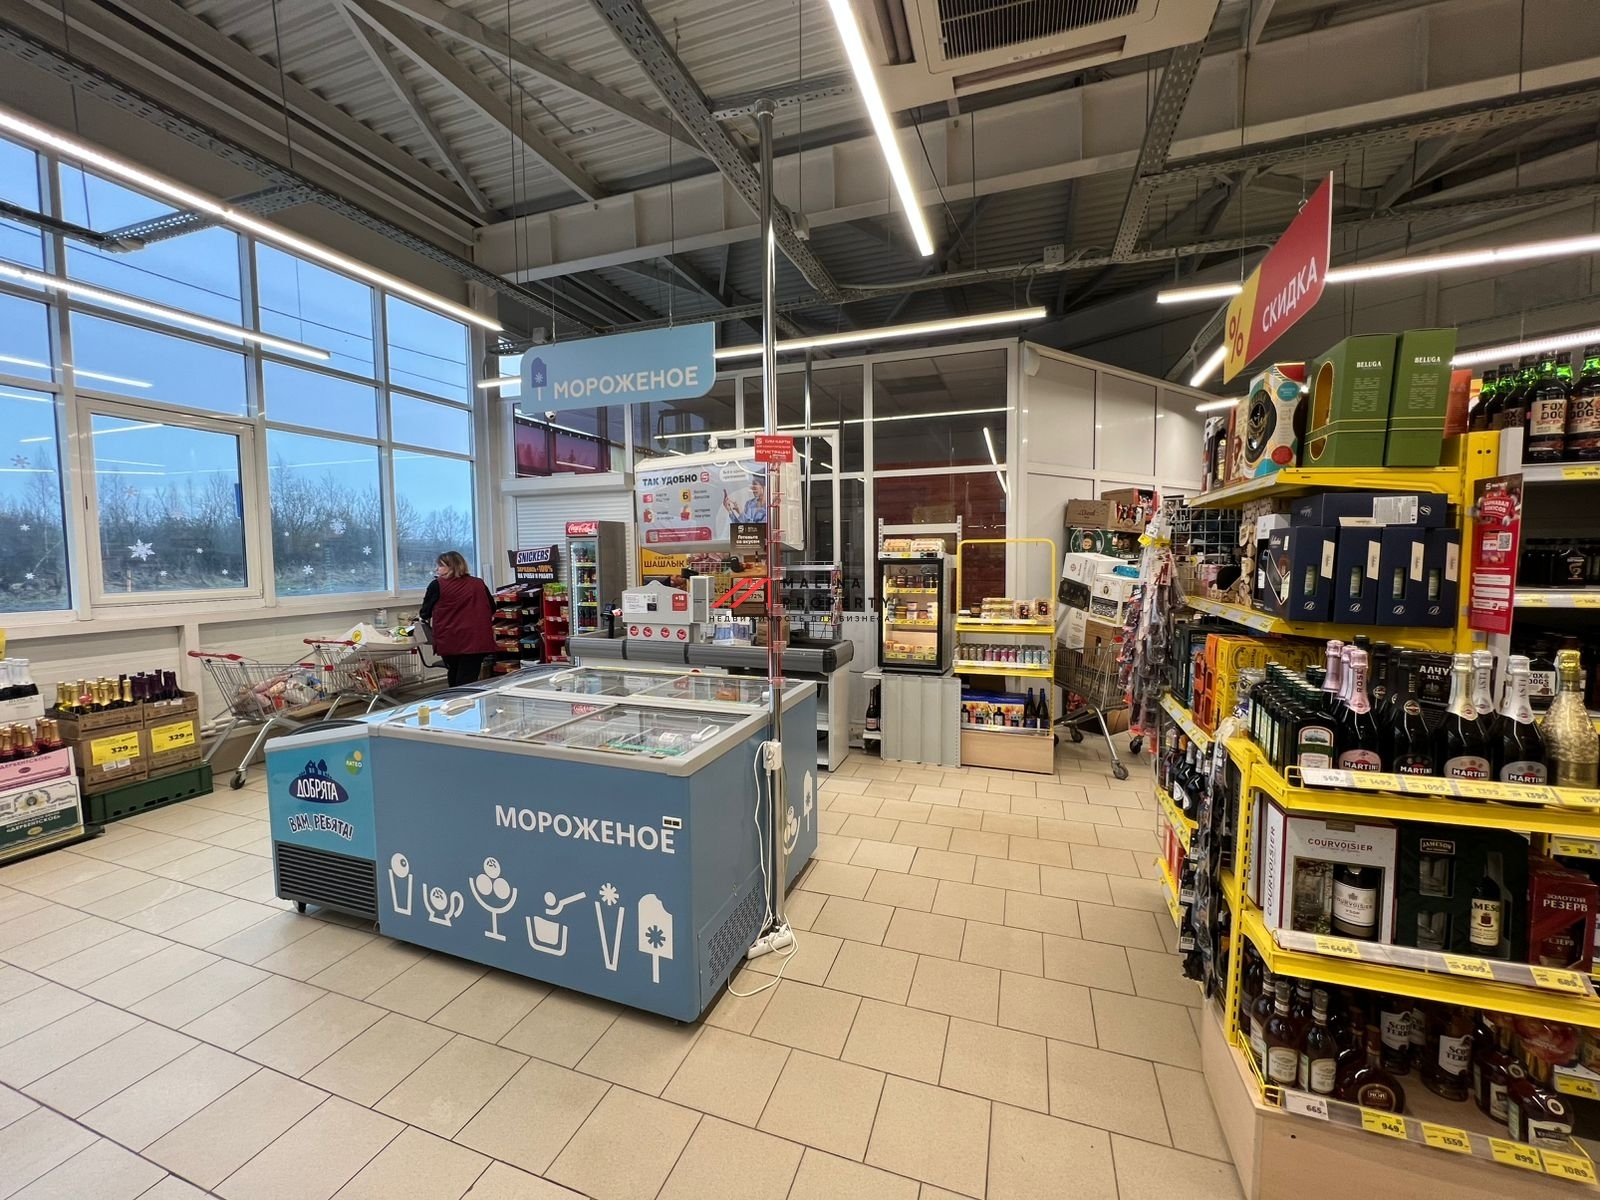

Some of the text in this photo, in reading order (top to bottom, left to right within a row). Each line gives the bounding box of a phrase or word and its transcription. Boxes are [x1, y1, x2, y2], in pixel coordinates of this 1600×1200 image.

[1262, 256, 1318, 333] СКИДКА
[1414, 356, 1441, 364] BELUGA
[554, 366, 699, 401] МОРОЖЕНОЕ
[642, 473, 698, 486] ТАК УДОБНО
[517, 549, 550, 564] SNICKERS
[644, 560, 685, 568] ШАШЛЫК
[168, 733, 185, 742] 329
[110, 745, 129, 754] 329
[1344, 760, 1379, 771] MARTINI
[1400, 765, 1433, 774] MARTINI
[1452, 768, 1488, 778] MARTINI
[1509, 774, 1545, 784] MARTINI
[296, 778, 339, 801] ДОБРЯТА
[288, 813, 354, 841] ВАМ, РЕБЯТА!
[495, 804, 676, 854] МОРОЖЕНОЕ
[1308, 838, 1373, 851] COURVOISIER
[1422, 841, 1452, 850] JAMESON
[1267, 826, 1276, 916] COURVOISIER
[1547, 893, 1587, 904] ЗОЛОТОЙ
[1543, 900, 1588, 912] РЕЗЕРВ
[1306, 1104, 1322, 1114] 665
[1381, 1122, 1399, 1133] 949
[1442, 1136, 1464, 1147] 1559
[1514, 1153, 1534, 1165] 899
[1562, 1164, 1588, 1178] 1089
